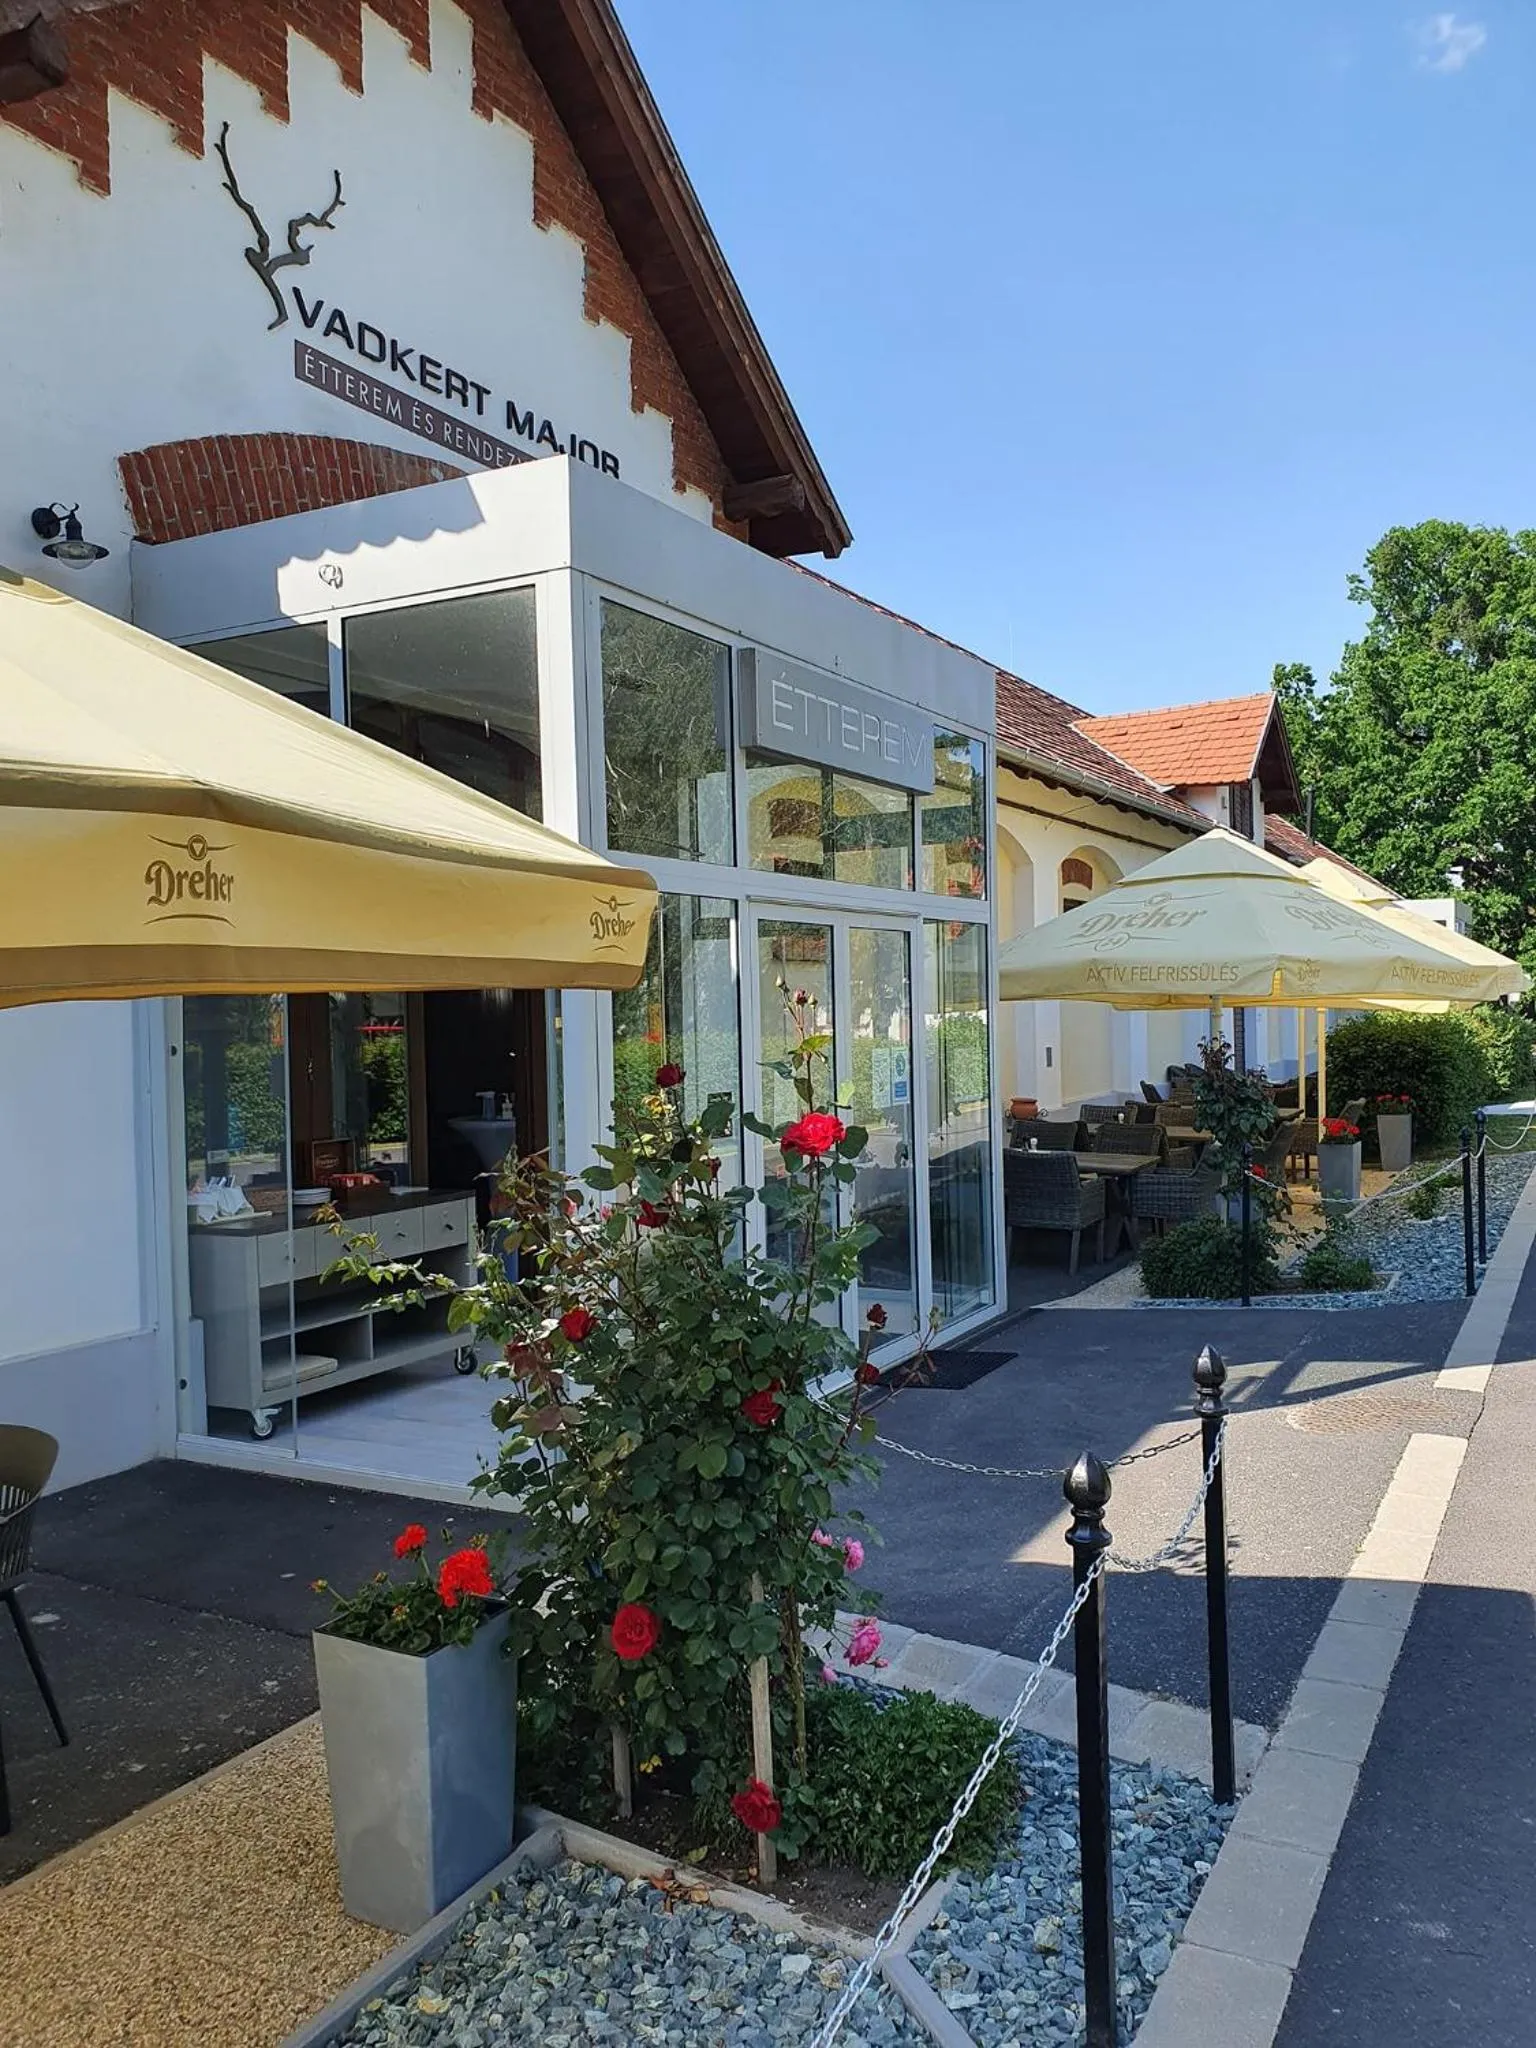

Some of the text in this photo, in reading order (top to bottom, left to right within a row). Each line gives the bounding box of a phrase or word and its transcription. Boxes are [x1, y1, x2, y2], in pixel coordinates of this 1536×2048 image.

[291, 286, 620, 480] VADKERT MAJOR
[304, 349, 403, 421] ÉTTEREM
[412, 401, 434, 435] ÉS
[772, 671, 928, 768] ÉTTEREM
[144, 859, 235, 907] Dreher
[589, 911, 636, 940] Dreher
[1068, 905, 1208, 940] Dreher
[1130, 961, 1241, 982] FELFRISSÜLÉS
